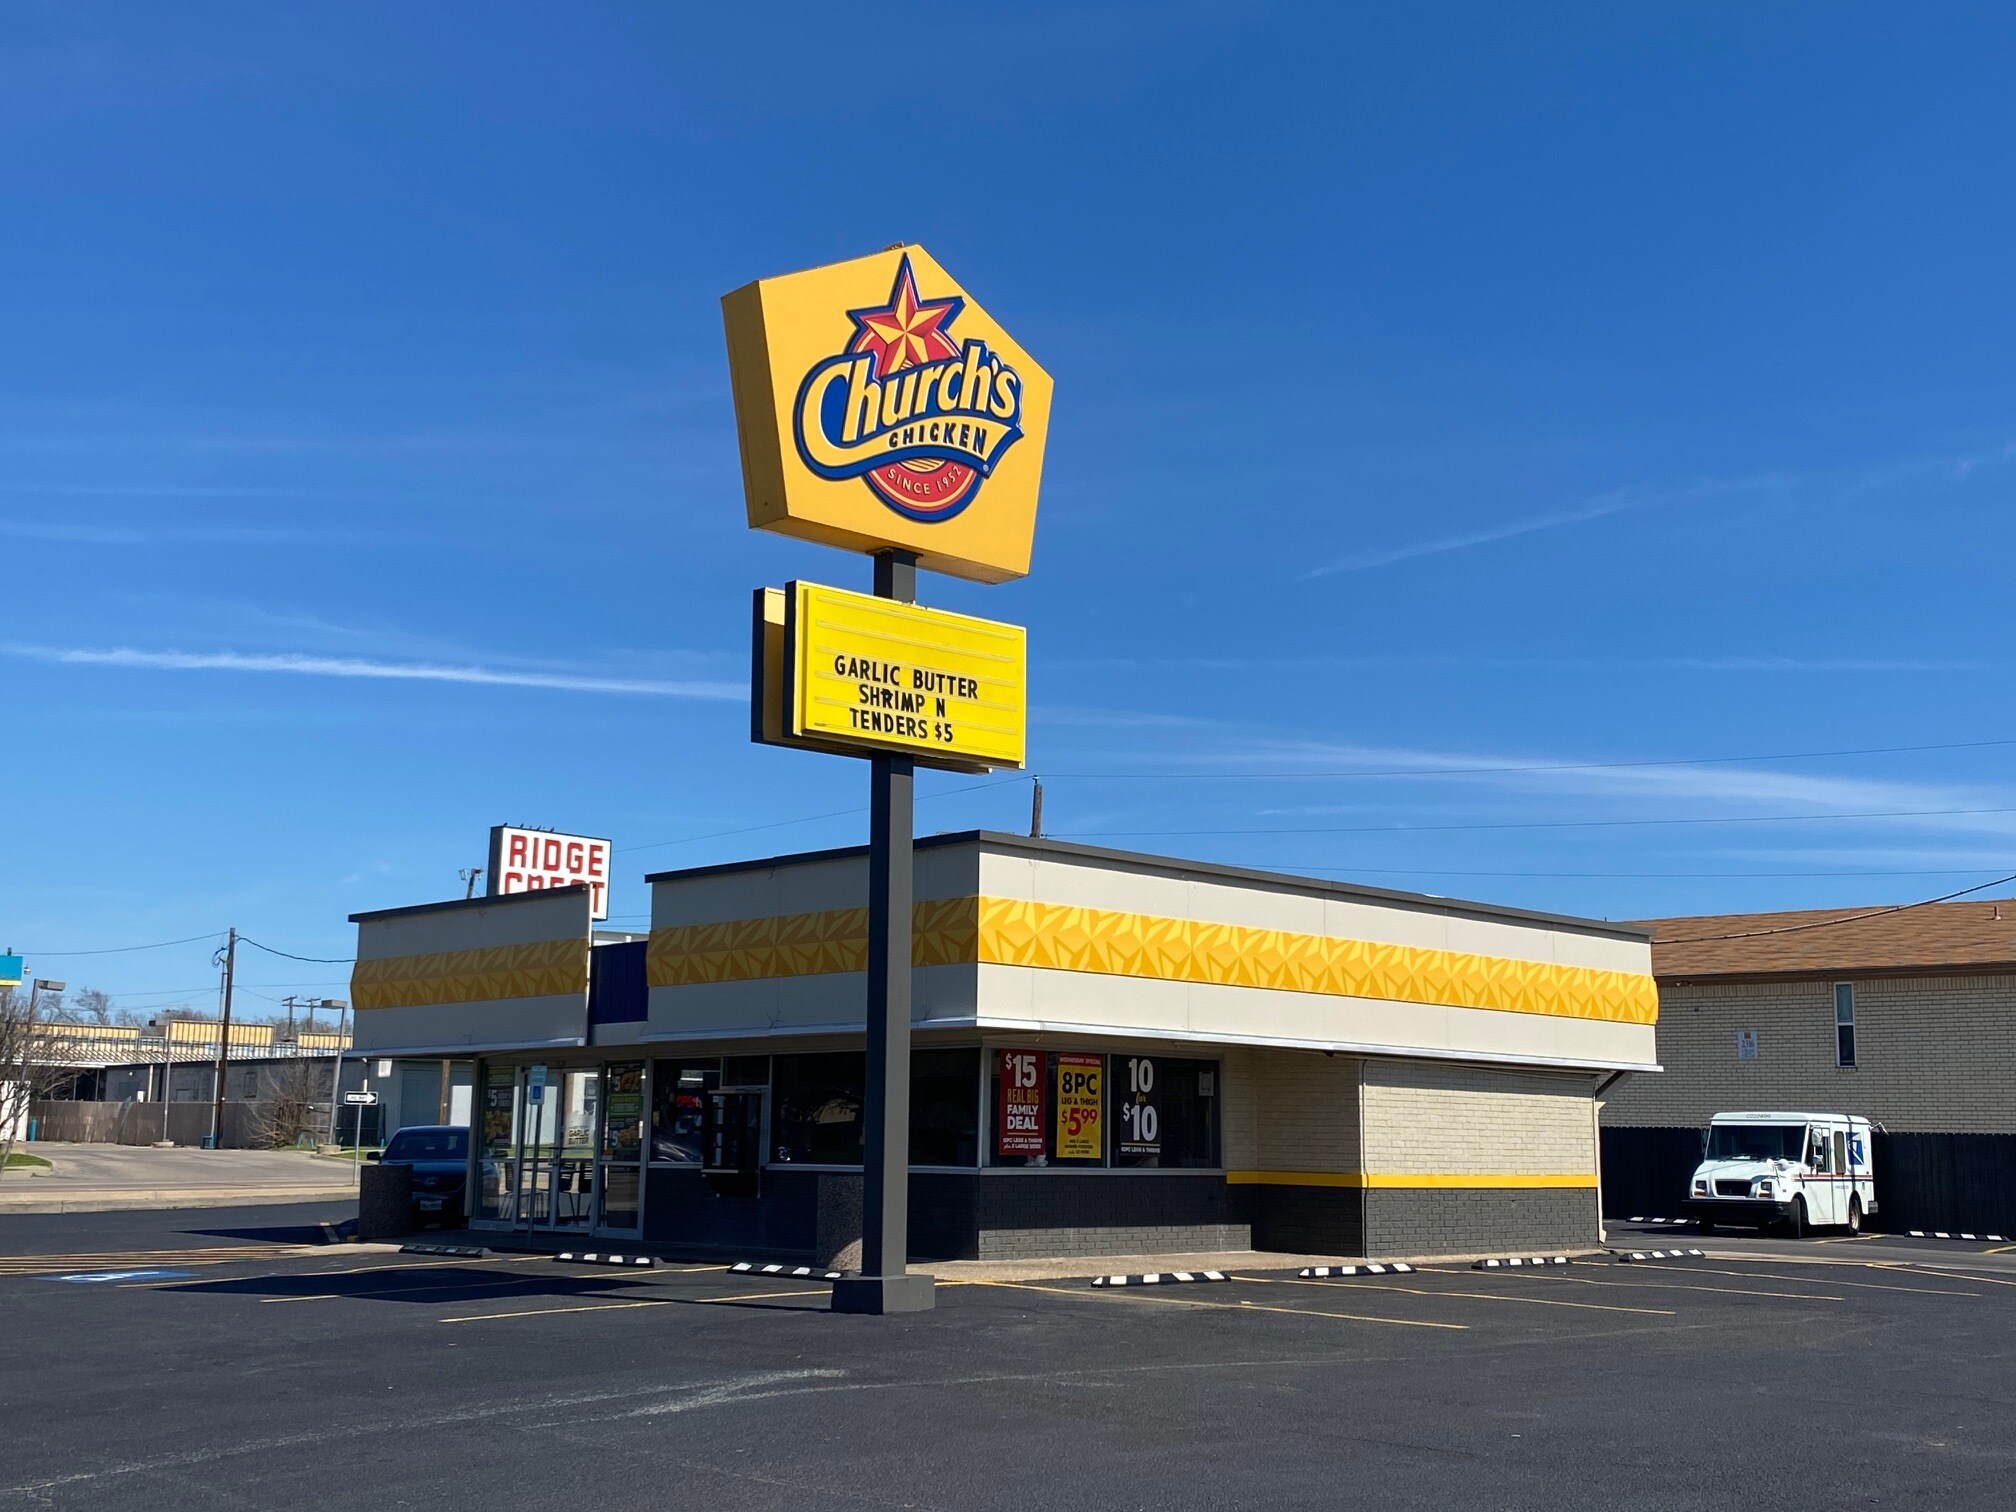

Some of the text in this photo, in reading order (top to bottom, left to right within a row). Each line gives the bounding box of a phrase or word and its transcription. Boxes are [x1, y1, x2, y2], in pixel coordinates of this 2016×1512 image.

[802, 345, 1016, 466] Church's
[888, 422, 987, 456] CHICKEN
[888, 465, 962, 495] SINCE 1952
[834, 655, 978, 699] GARLIC BUTTER
[859, 684, 946, 718] SHRIMP N
[849, 708, 953, 743] TENDERS $5
[509, 834, 604, 877] RIDGE
[504, 872, 605, 914] CRT
[1005, 1053, 1037, 1087] $15
[1062, 1071, 1097, 1096] 8PC
[1128, 1058, 1154, 1092] 10
[1007, 1088, 1039, 1104] REAL BIG
[1007, 1104, 1039, 1115] FAMILY
[1061, 1097, 1072, 1105] LEG
[1080, 1098, 1098, 1106] THIGH
[568, 1129, 590, 1137] GARLIC
[1007, 1115, 1039, 1130] DEAL
[1123, 1102, 1158, 1141] $10
